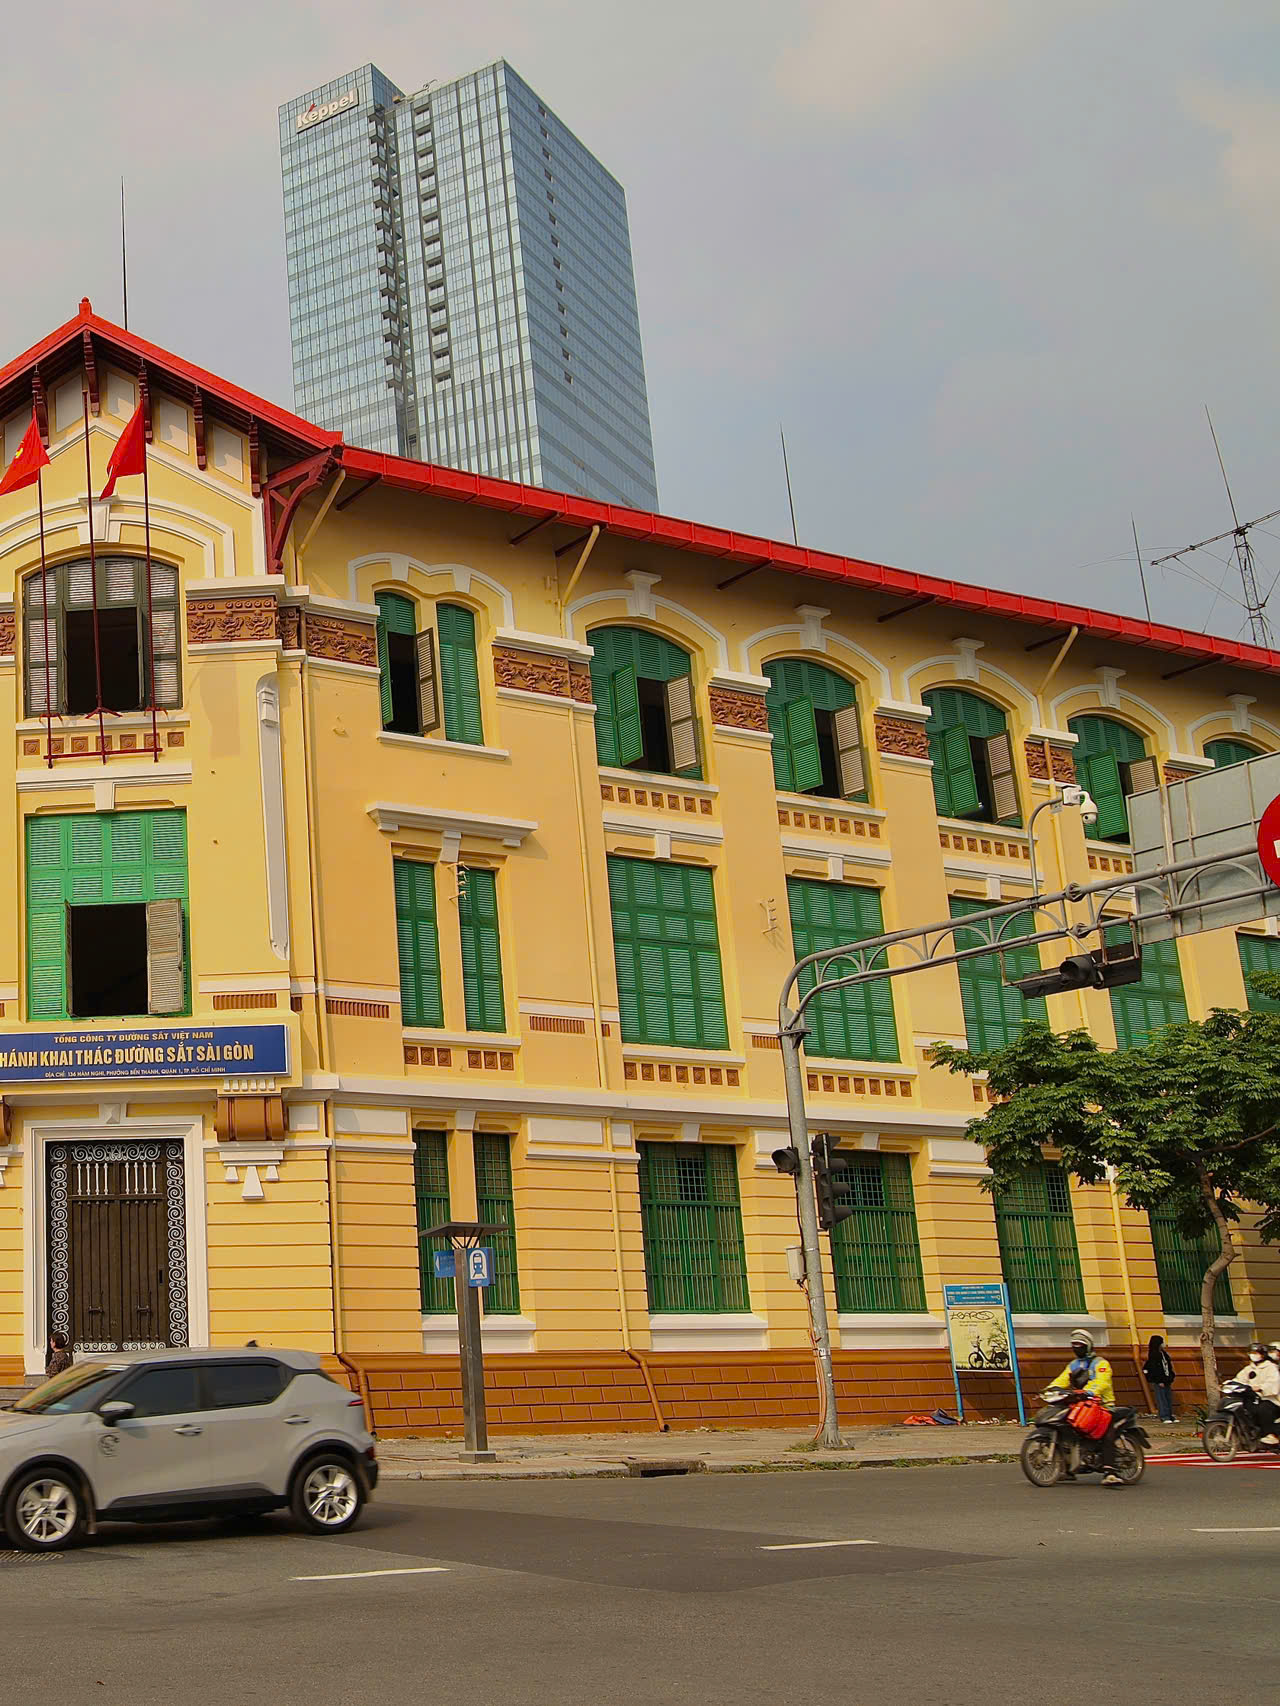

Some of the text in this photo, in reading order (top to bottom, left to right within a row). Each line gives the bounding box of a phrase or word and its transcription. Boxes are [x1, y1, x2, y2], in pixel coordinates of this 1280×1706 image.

[297, 91, 355, 128] Keppel
[54, 1033, 77, 1044] TỔNG
[79, 1033, 104, 1043] CÔNG
[106, 1034, 117, 1042] TY
[171, 1031, 190, 1040] VIỆT
[40, 1050, 74, 1067] KHAI
[76, 1046, 113, 1065] THÁC
[115, 1044, 164, 1065] ĐƯỜNG
[167, 1042, 194, 1063] SẮT
[196, 1043, 220, 1062] SÀI
[223, 1041, 255, 1061] GÒN
